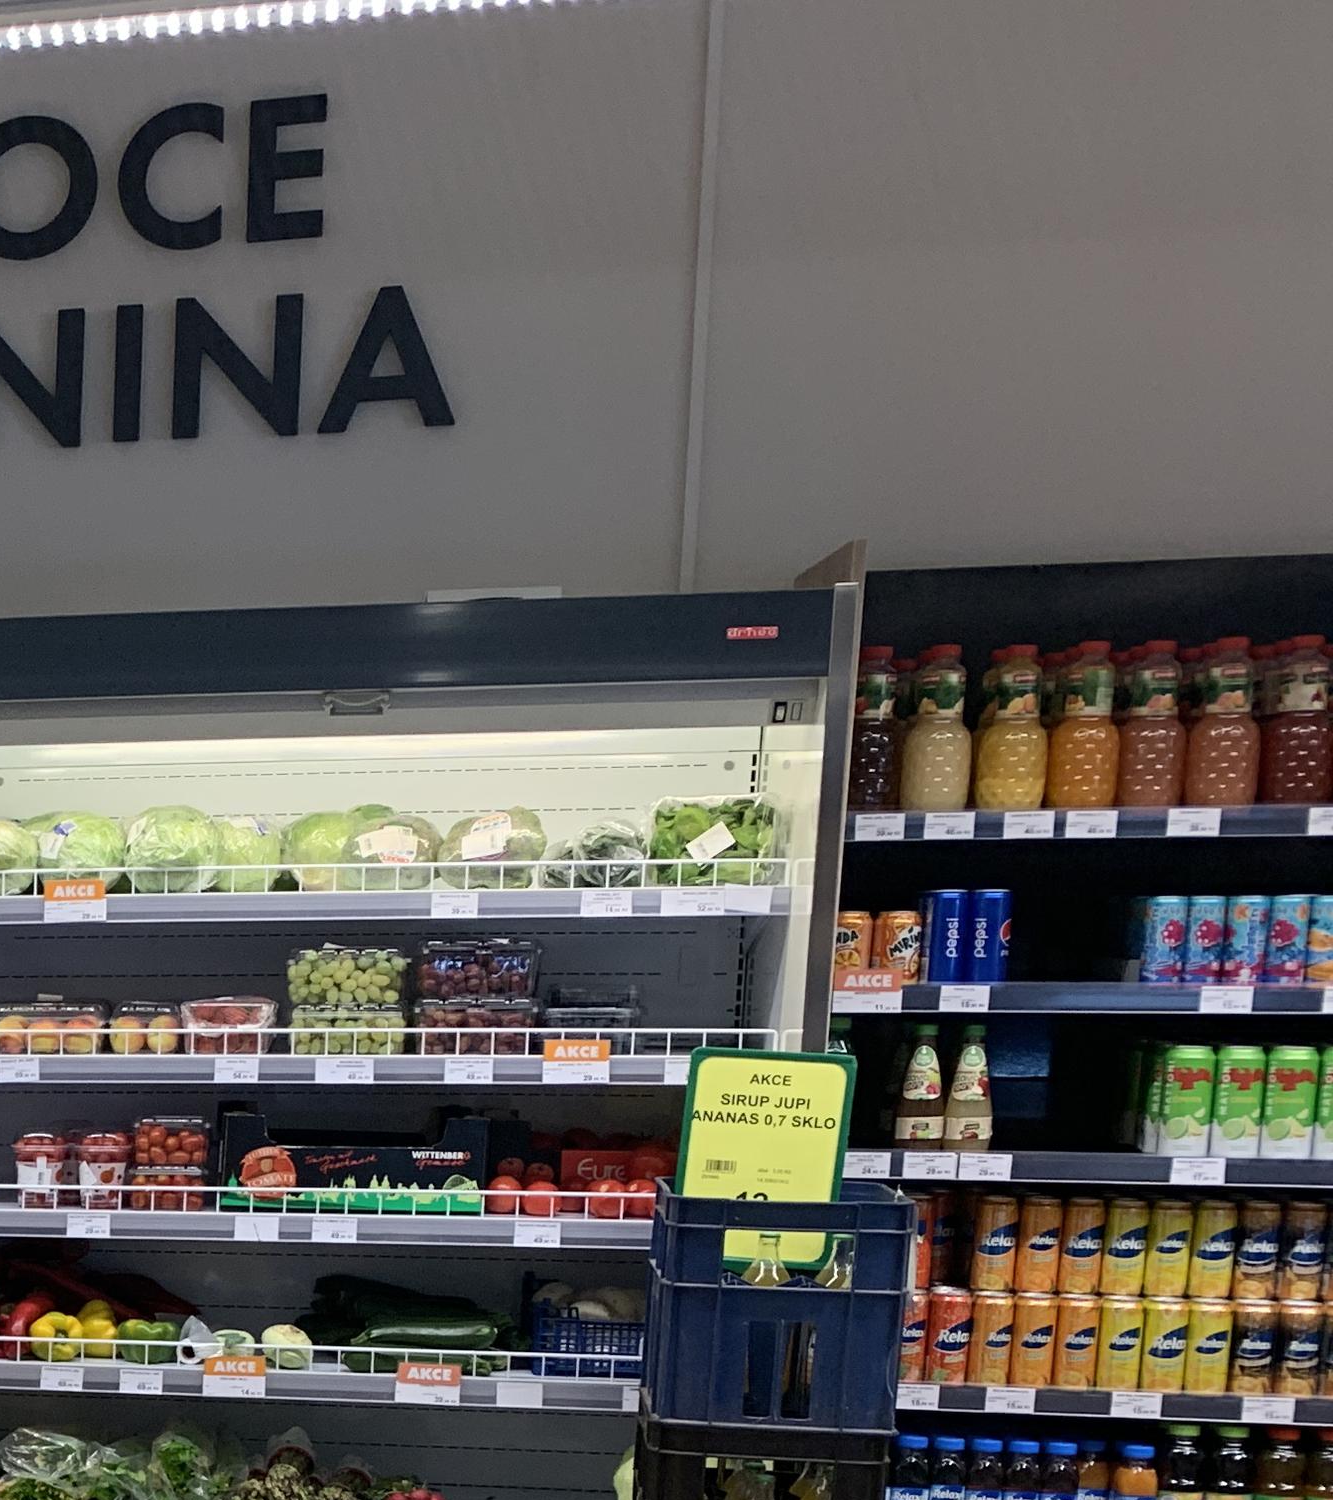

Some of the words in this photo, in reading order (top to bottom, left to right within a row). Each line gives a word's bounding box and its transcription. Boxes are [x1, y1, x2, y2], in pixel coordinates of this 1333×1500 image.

[53, 885, 96, 899] AKCE
[946, 918, 960, 958] pepsi
[974, 918, 987, 958] pepsi
[845, 974, 892, 987] AKCE
[553, 1045, 600, 1060] AKCE
[749, 1073, 793, 1087] AKCE
[721, 1093, 770, 1108] SIRUP
[774, 1096, 811, 1110] JUPI
[692, 1110, 759, 1125] ANANAS
[765, 1114, 787, 1128] 0,7
[791, 1117, 836, 1130] SKLO
[412, 1151, 471, 1160] WITTENBERG
[213, 1360, 256, 1373] AKCE
[407, 1366, 452, 1381] AKCE
